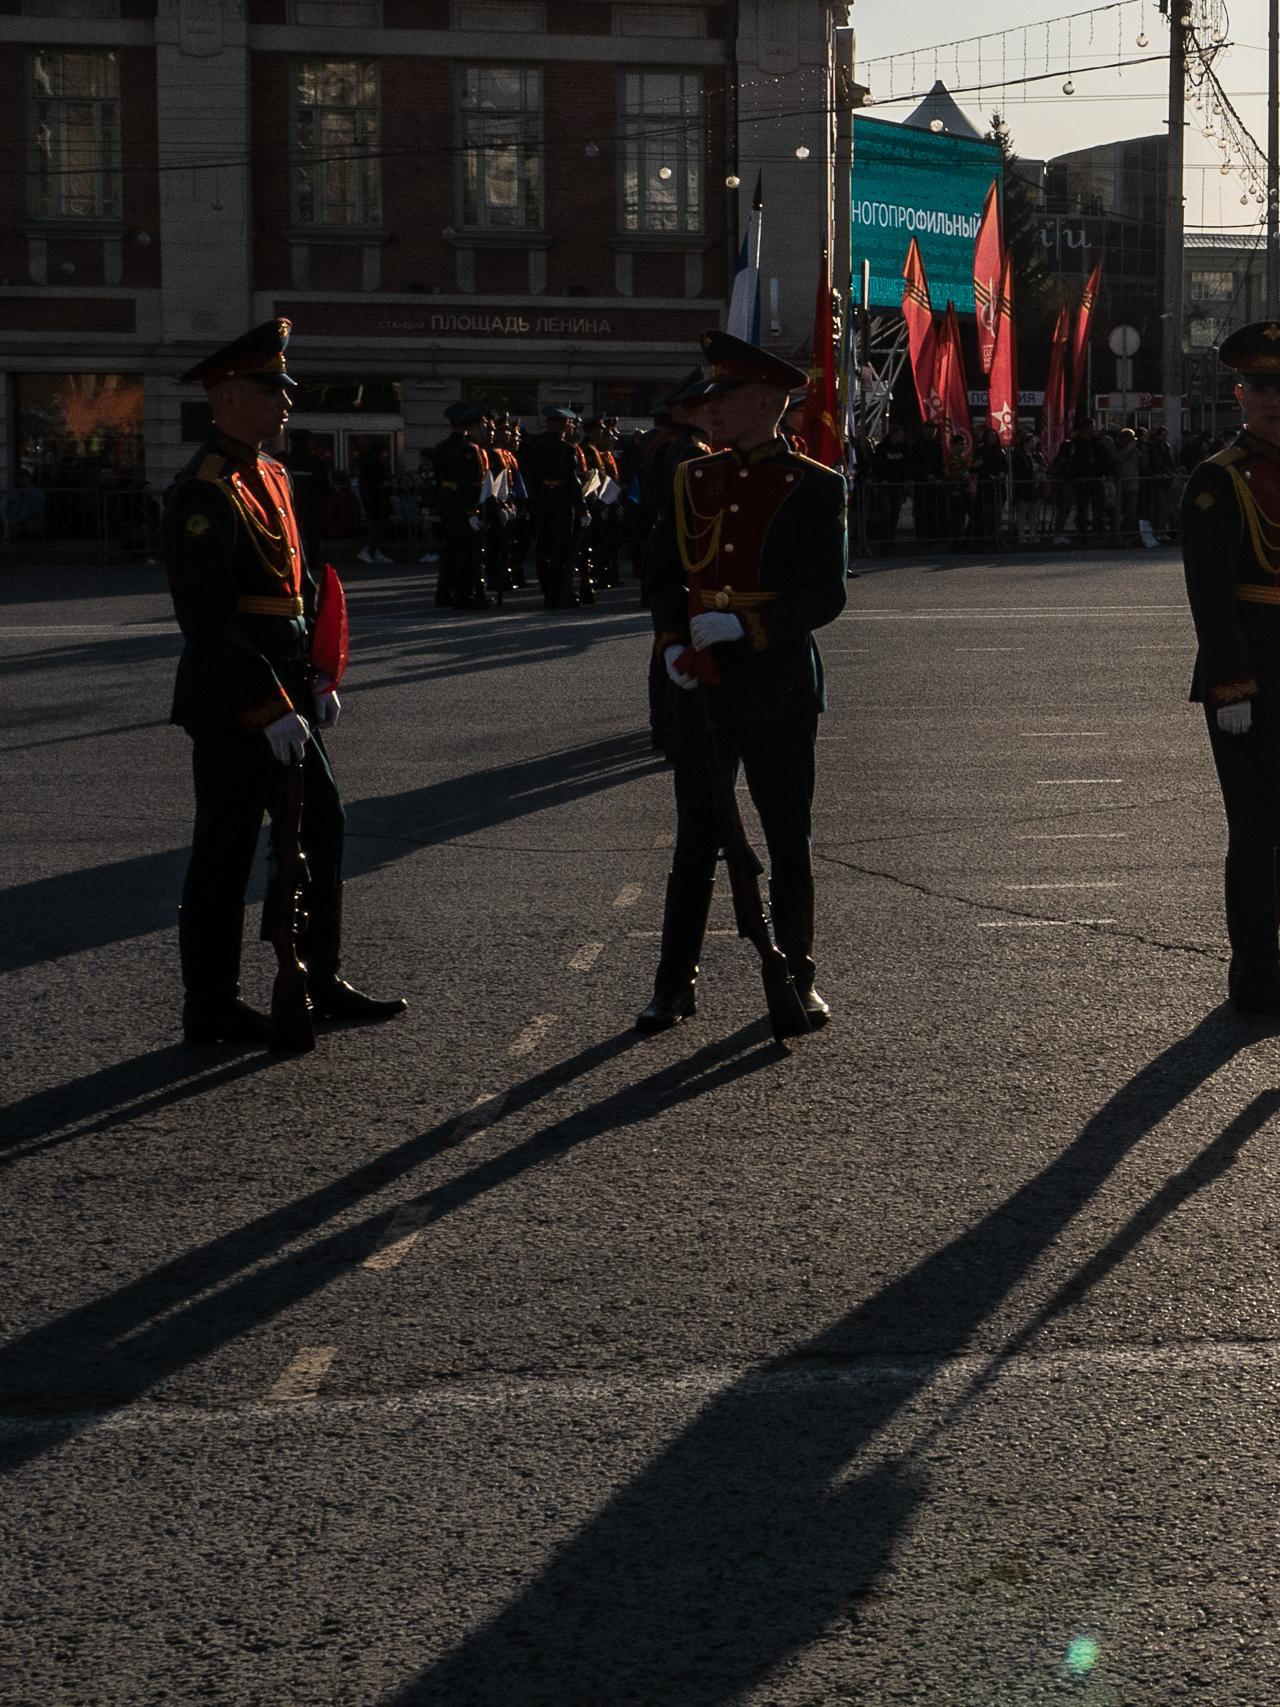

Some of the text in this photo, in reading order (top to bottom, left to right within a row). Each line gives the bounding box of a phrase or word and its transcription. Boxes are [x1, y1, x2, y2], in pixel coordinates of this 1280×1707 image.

[431, 315, 530, 334] ПЛОЩАДЬ
[535, 317, 611, 334] ЛЕНИНА
[971, 392, 1036, 404] ПОИЯ
